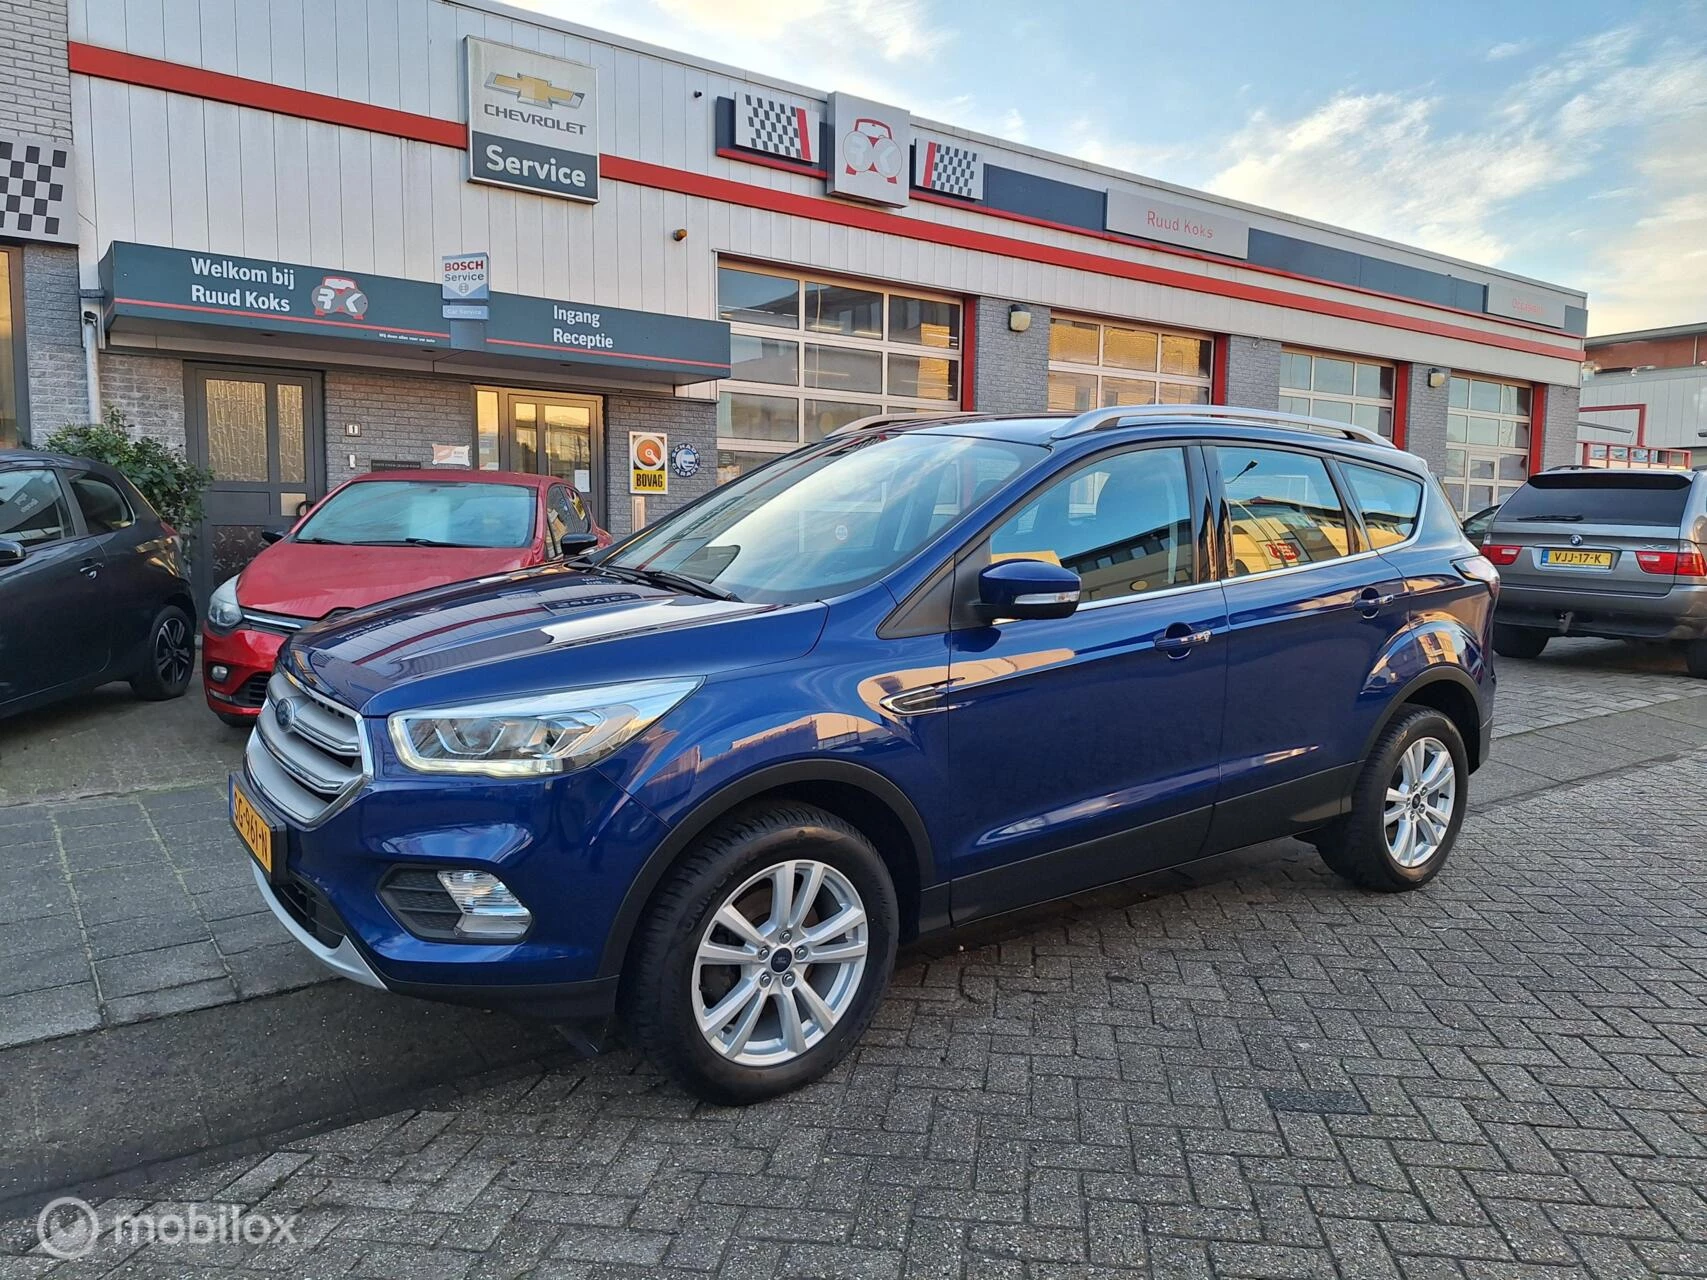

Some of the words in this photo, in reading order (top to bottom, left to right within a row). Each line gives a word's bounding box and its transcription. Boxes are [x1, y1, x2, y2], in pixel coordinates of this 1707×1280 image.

[484, 103, 587, 135] CHEVROLET
[486, 144, 586, 187] Service
[1147, 210, 1180, 231] Ruud
[1184, 219, 1214, 239] Koks
[191, 257, 268, 283] Welkom
[272, 266, 295, 290] bij
[444, 272, 485, 281] Service
[445, 260, 484, 271] BOSCH
[191, 285, 241, 307] Ruud
[245, 291, 291, 312] Koks
[553, 304, 600, 327] Ingang
[553, 328, 613, 349] Receptie
[636, 473, 663, 487] BOVAG
[1554, 552, 1602, 564] VJJ-17-K
[234, 790, 268, 862] SG-961-N
